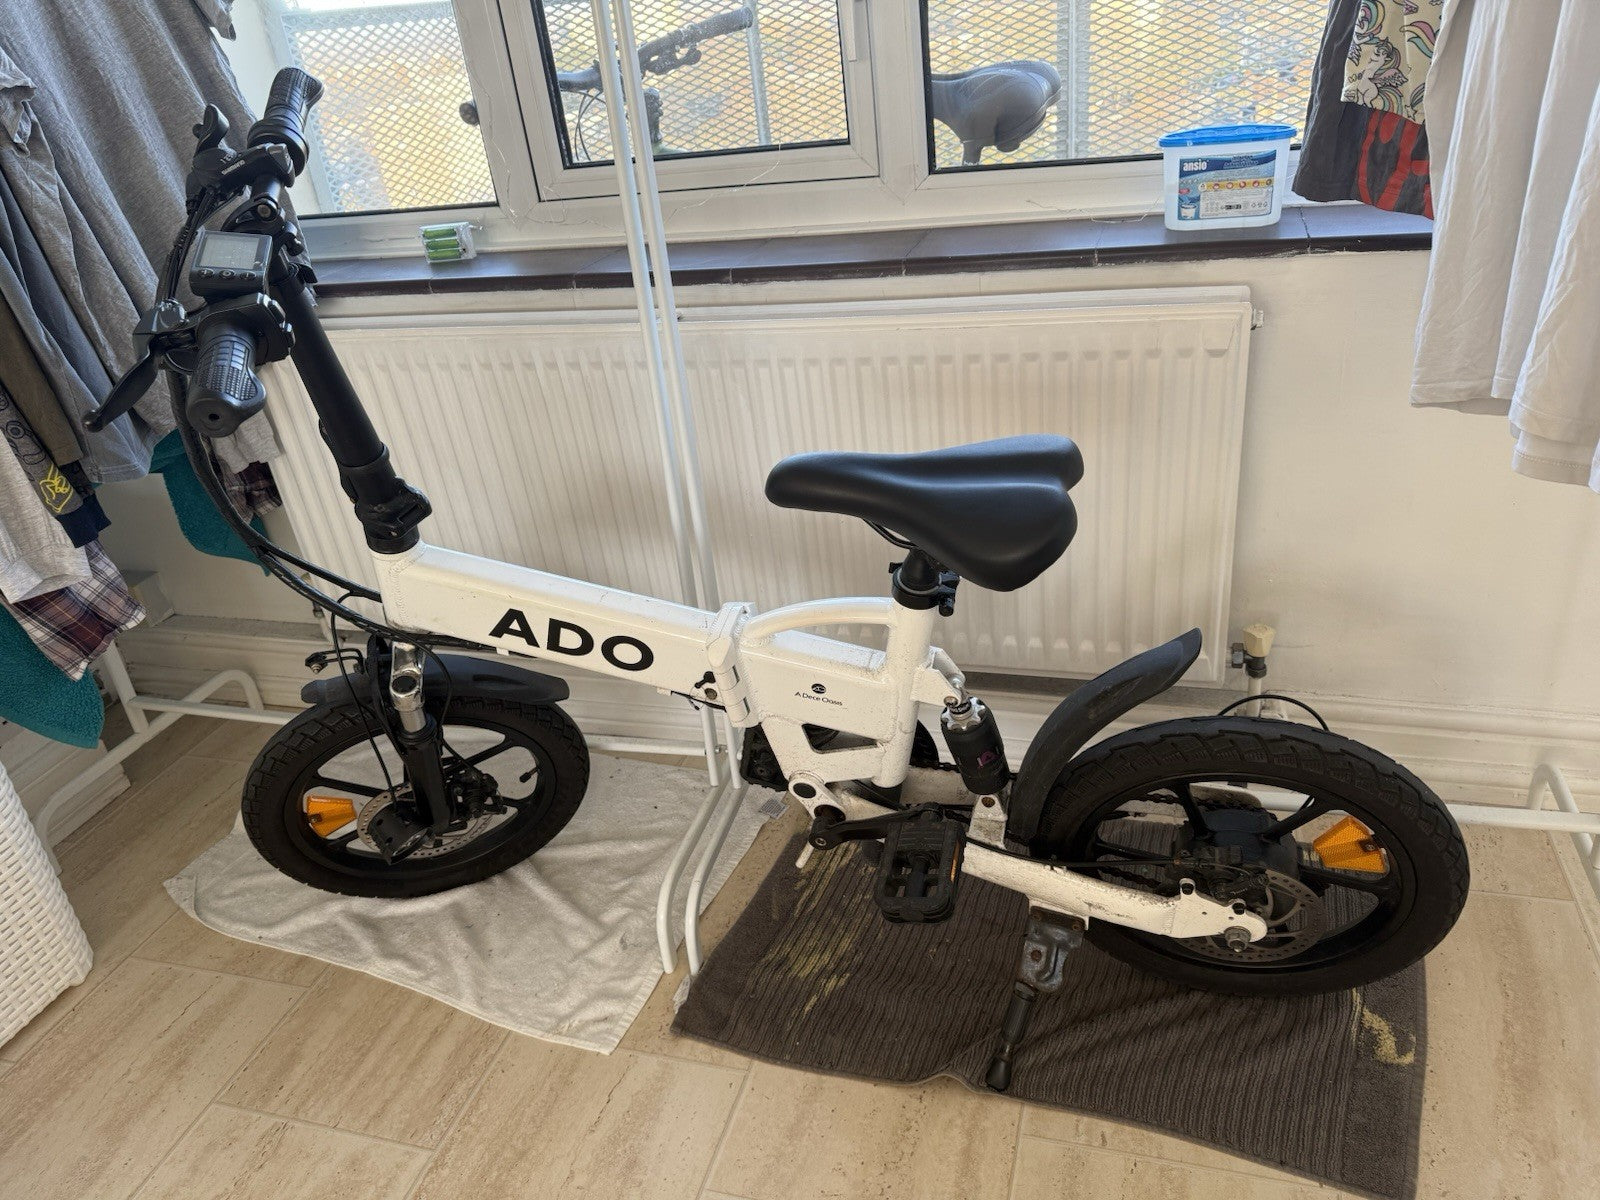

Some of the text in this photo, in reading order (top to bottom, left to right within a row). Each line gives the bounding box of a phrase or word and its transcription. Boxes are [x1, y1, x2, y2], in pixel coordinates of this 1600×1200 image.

[1183, 158, 1208, 171] ansio
[488, 607, 654, 671] ADO
[802, 692, 821, 701] Dece
